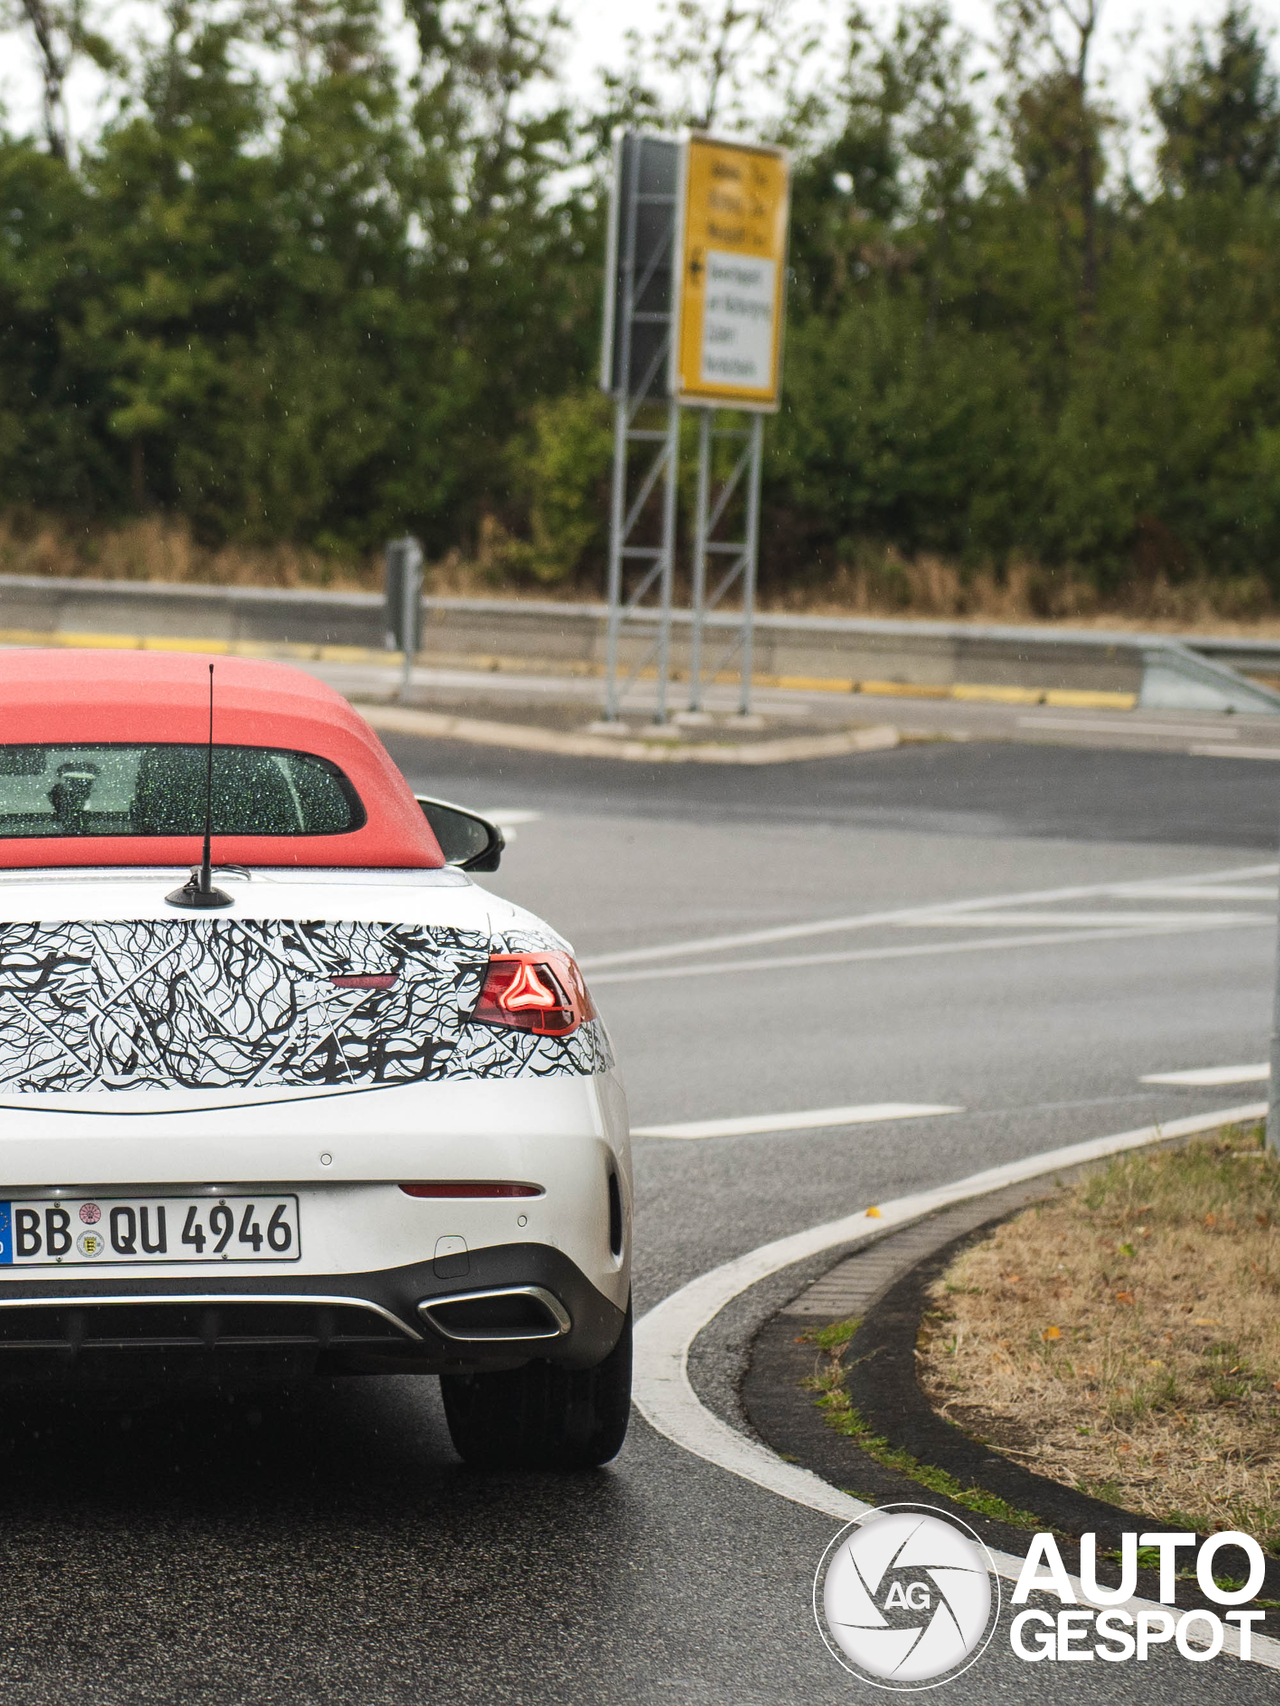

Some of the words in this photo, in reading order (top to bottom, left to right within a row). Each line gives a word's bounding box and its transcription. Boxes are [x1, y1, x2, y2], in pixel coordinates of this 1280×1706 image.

[15, 1208, 72, 1257] BB
[109, 1206, 167, 1255] QU
[181, 1204, 291, 1253] 4946
